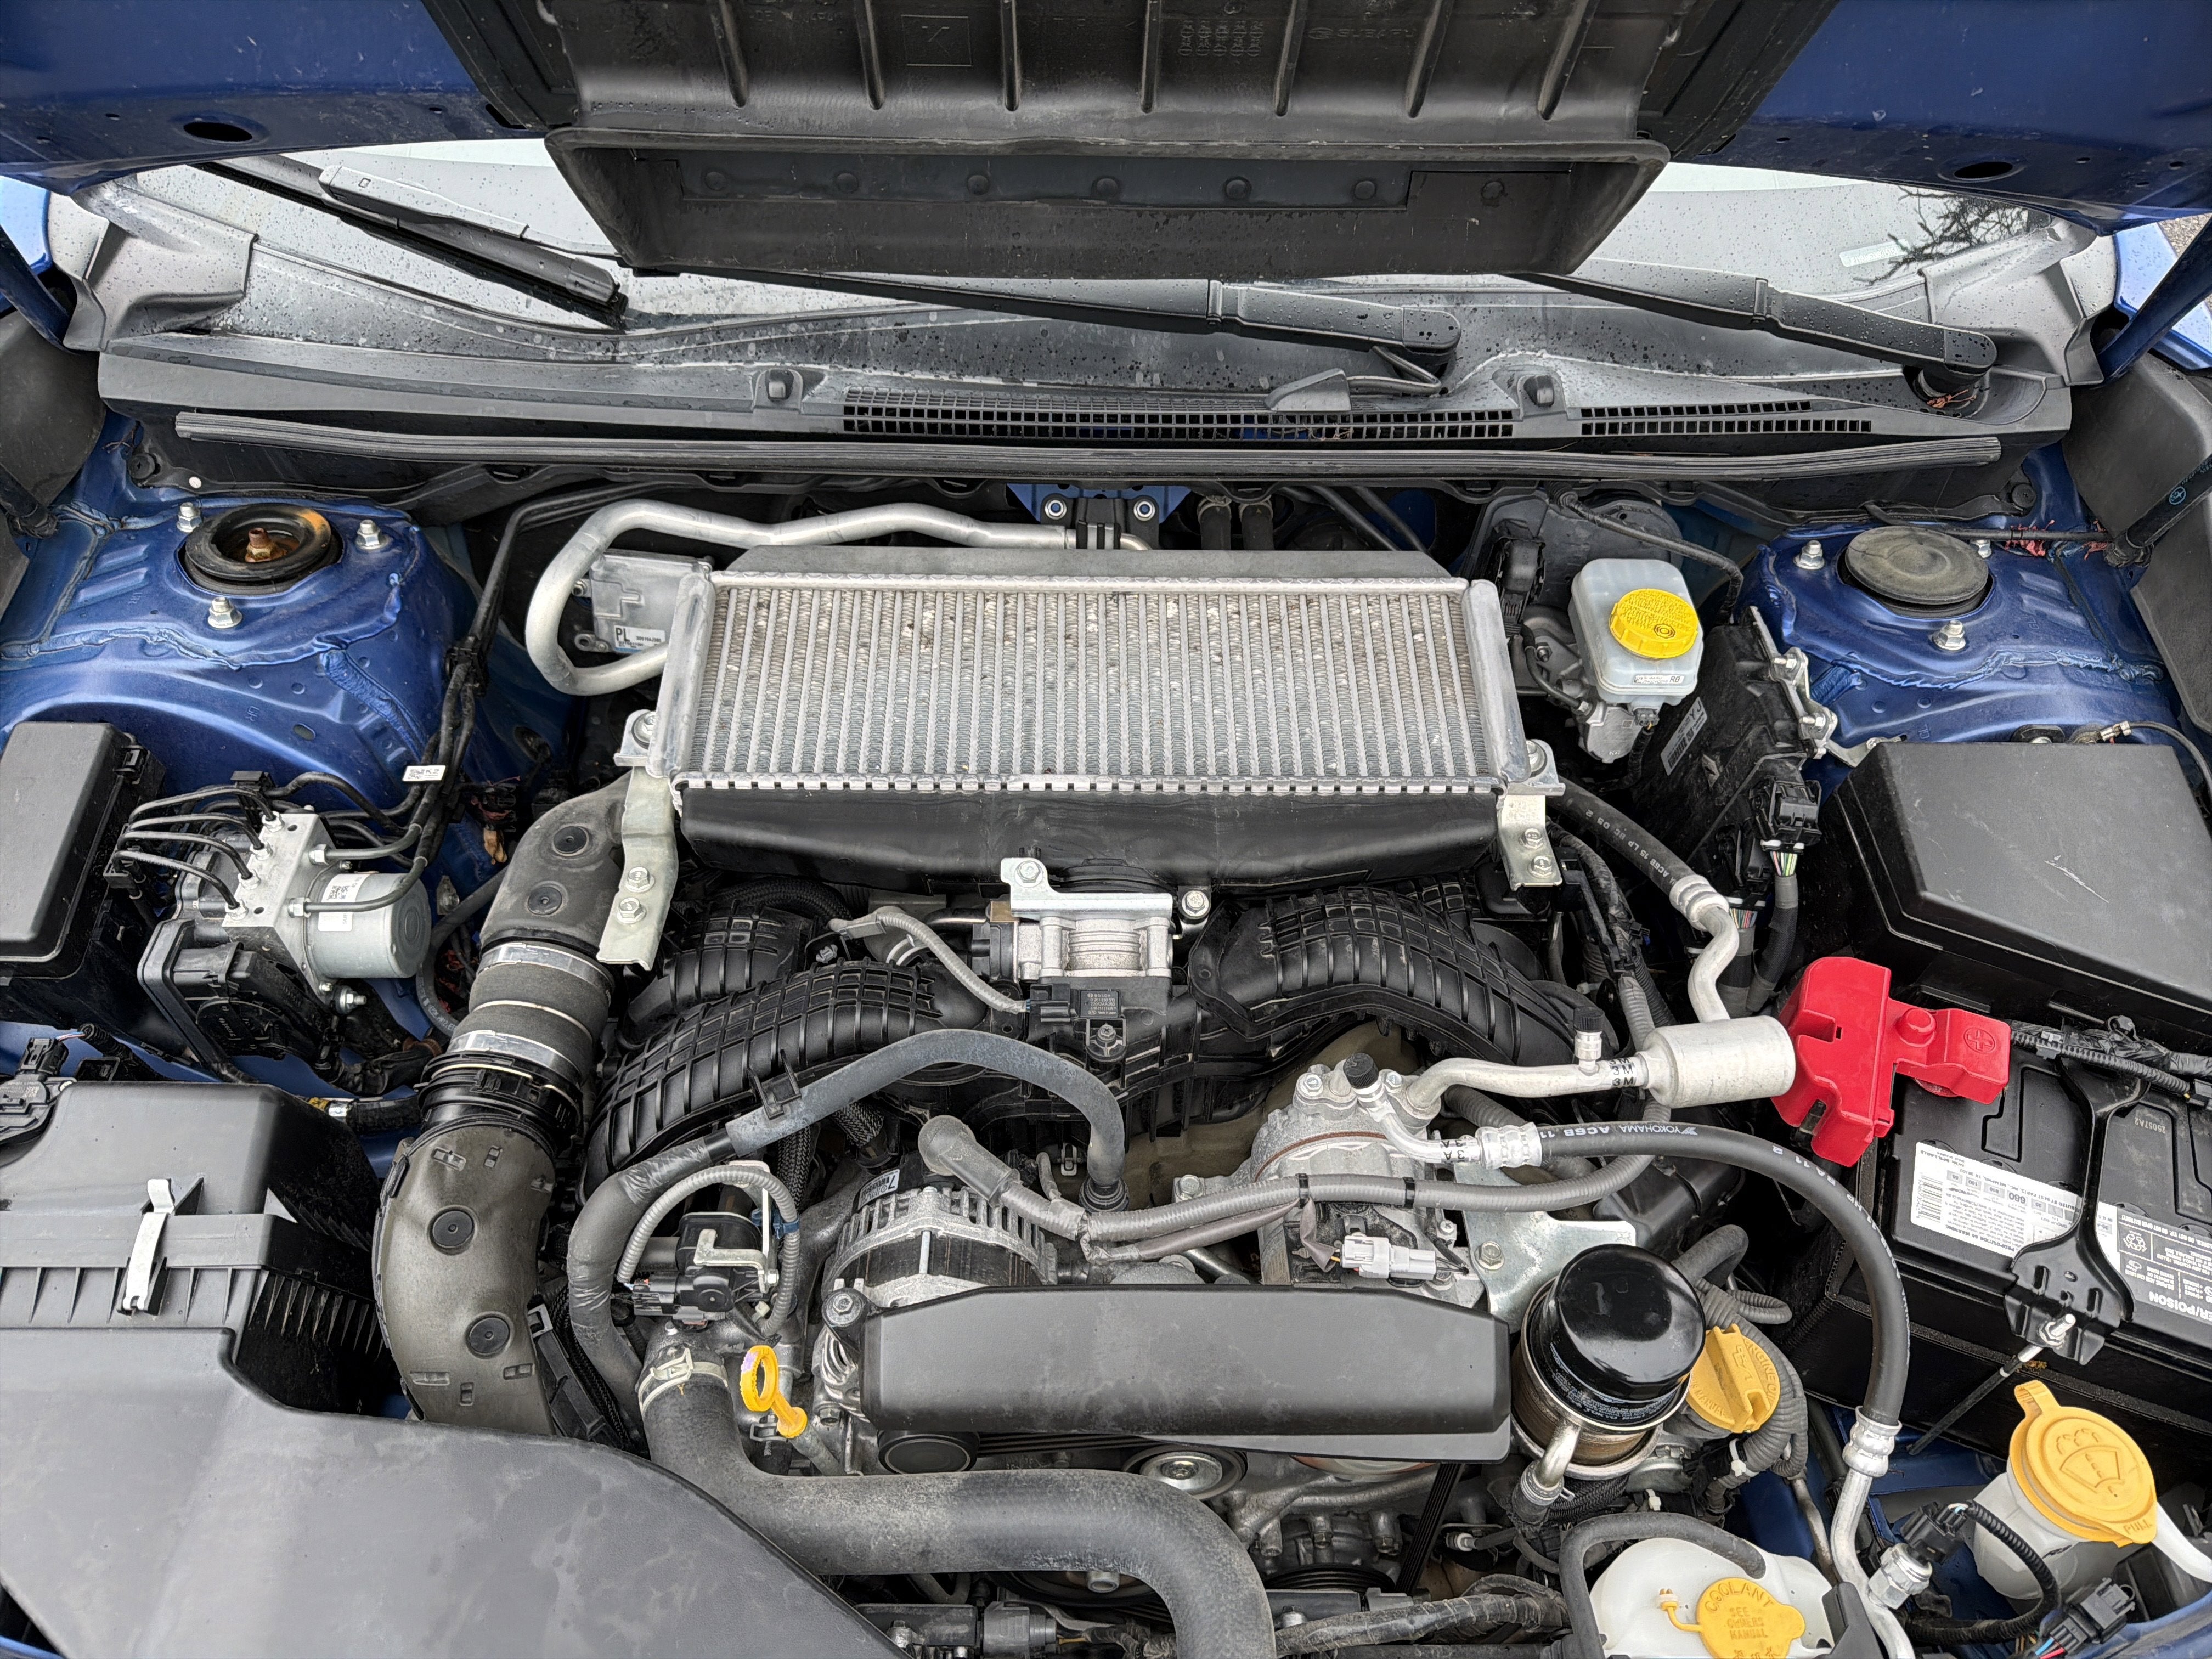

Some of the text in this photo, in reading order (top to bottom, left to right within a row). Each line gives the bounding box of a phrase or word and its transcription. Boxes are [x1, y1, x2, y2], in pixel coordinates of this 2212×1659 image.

[1585, 809, 1594, 817] 2
[1628, 840, 1639, 851] LP
[1639, 849, 1649, 860] 15
[1650, 858, 1669, 878] AC6B
[1612, 1065, 1633, 1075] 3M
[1613, 1076, 1634, 1086] 3M
[1619, 1125, 1681, 1134] YOKOHAMA
[2134, 1116, 2166, 1134] 25057A2
[1540, 1130, 1555, 1138] 11
[1773, 1146, 1783, 1155] 2
[1796, 1156, 1810, 1168] 11
[888, 1175, 896, 1190] 7
[1847, 1194, 1863, 1212] HP
[2008, 1192, 2026, 1204] 680
[2121, 1214, 2141, 1226] BATTERY!
[2142, 1221, 2153, 1229] OPEN
[1945, 1224, 1970, 1236] WARNING
[2179, 1233, 2187, 1241] NOT
[2157, 1254, 2172, 1263] FOLLOW
[1696, 1390, 1727, 1418] MANUAL
[2123, 1519, 2153, 1535] PULL
[1705, 1582, 1774, 1613] COOLANT
[1729, 1606, 1750, 1617] SEE
[1727, 1617, 1764, 1628] OWNERS
[1729, 1628, 1769, 1640] MANUAL
